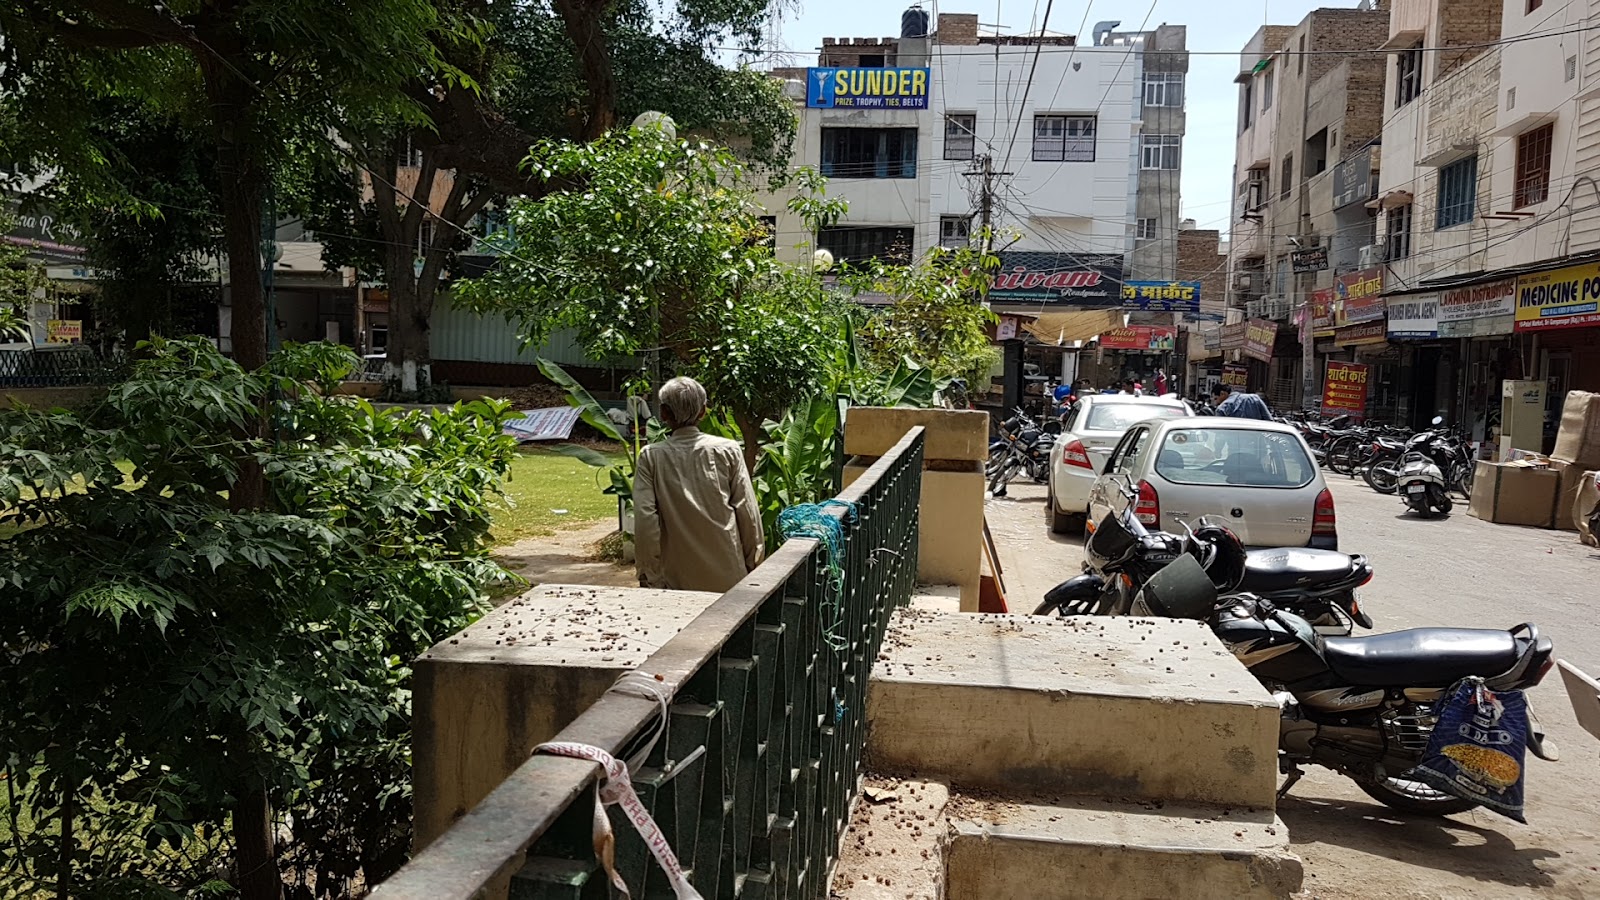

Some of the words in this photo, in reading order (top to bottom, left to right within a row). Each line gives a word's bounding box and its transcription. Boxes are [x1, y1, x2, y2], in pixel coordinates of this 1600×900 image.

[834, 69, 926, 96] SUNDER
[835, 98, 854, 107] PRIZE,
[856, 97, 884, 107] TROPHY,
[885, 98, 902, 107] TIES,
[903, 98, 922, 106] BELTS
[1060, 287, 1108, 297] Readymade
[1519, 280, 1578, 308] MEDICINE
[1328, 366, 1348, 382] शादी
[1349, 367, 1368, 384] कार्ड
